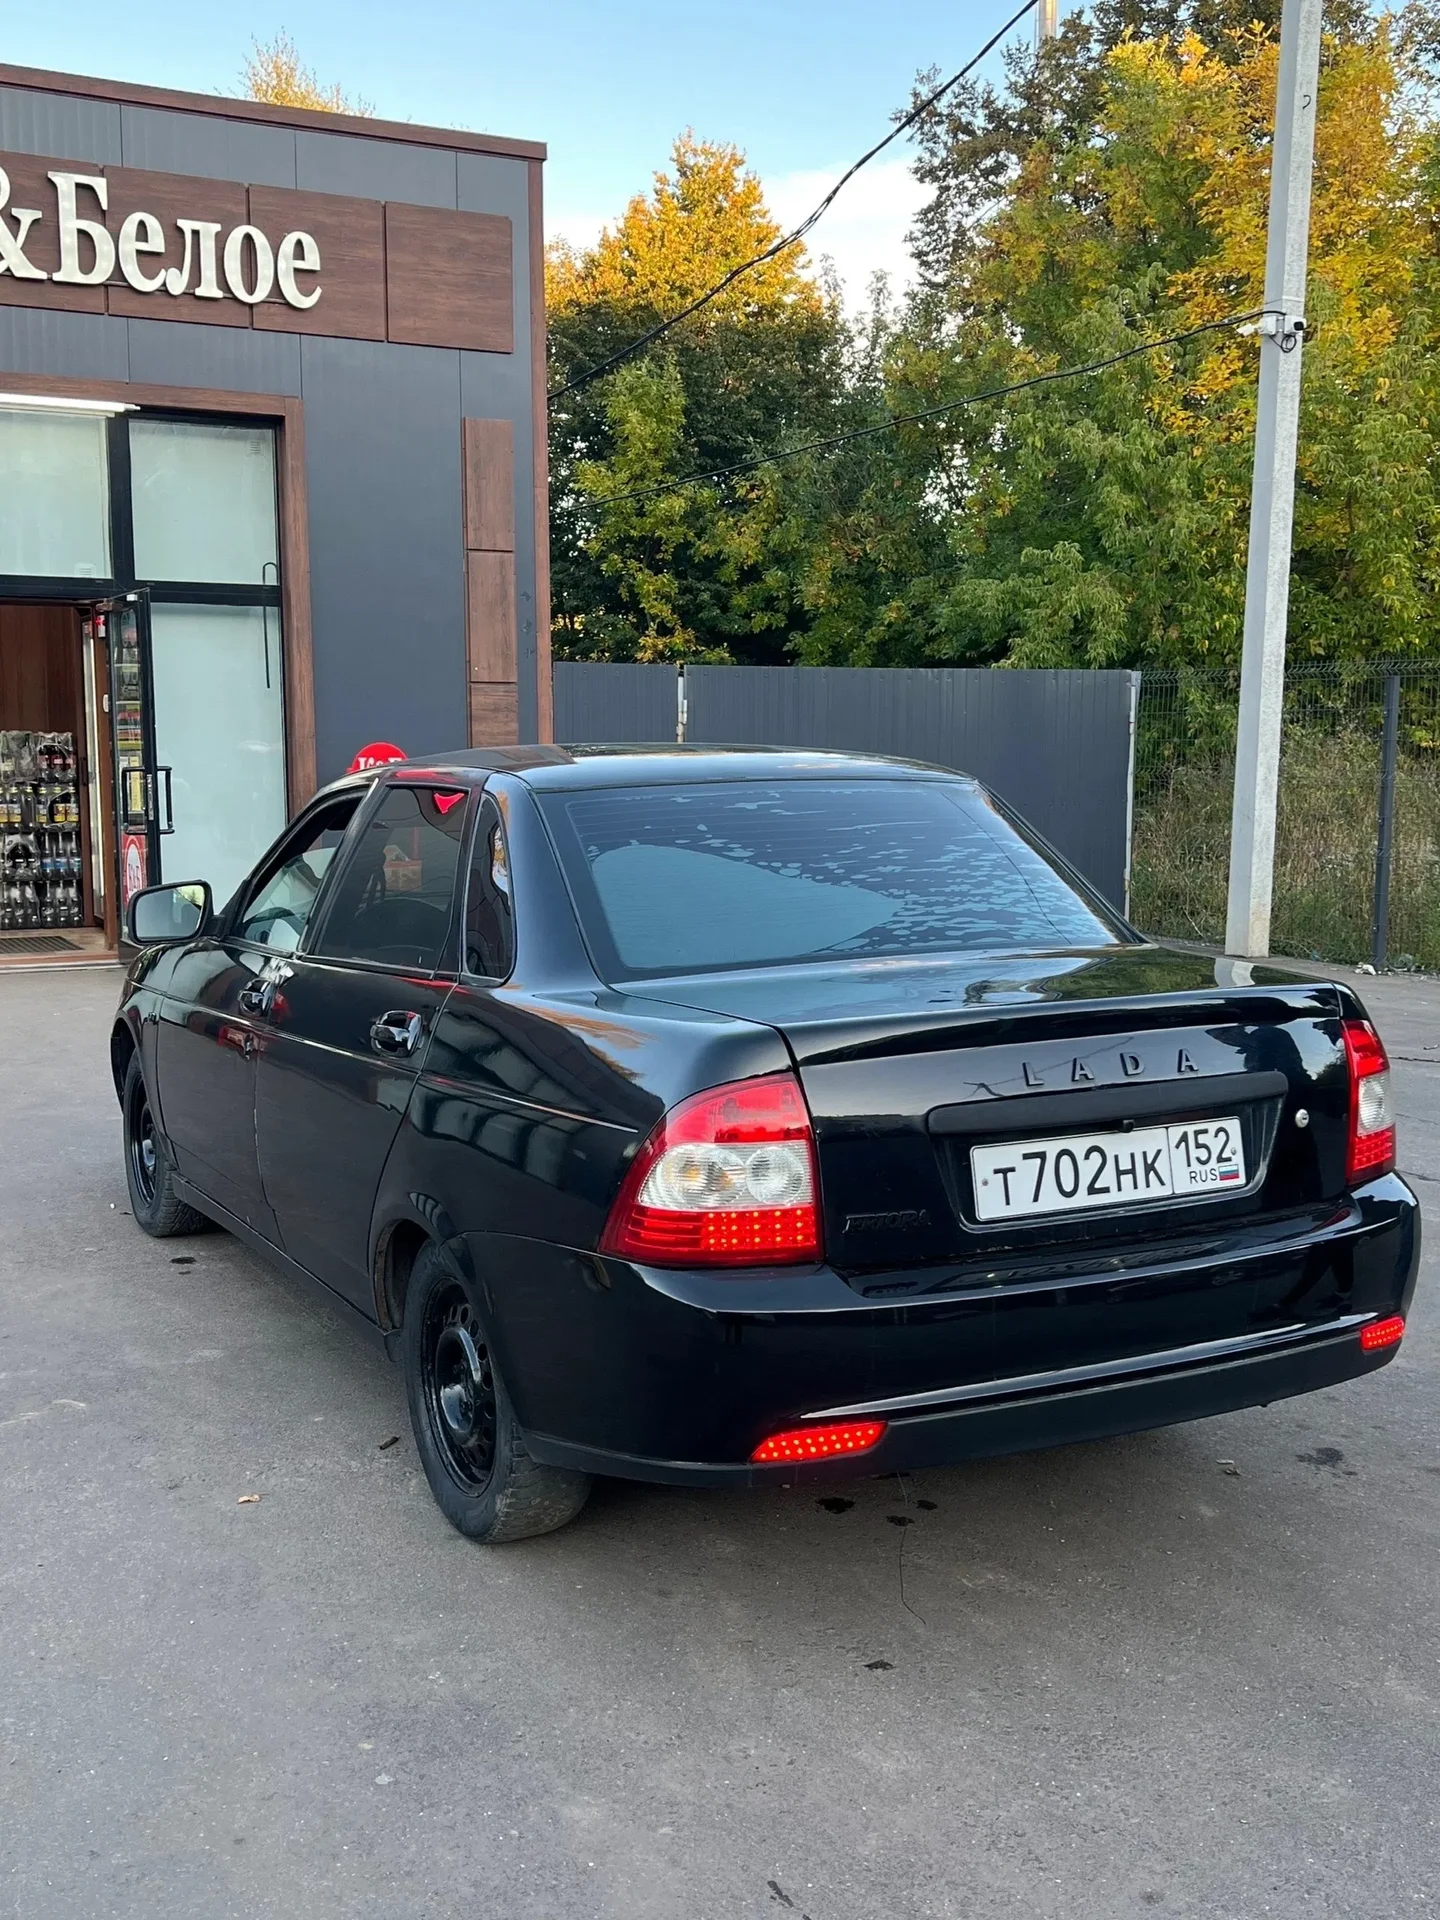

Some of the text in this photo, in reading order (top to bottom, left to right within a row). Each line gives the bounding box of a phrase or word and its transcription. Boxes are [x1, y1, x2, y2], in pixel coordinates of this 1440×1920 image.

[1022, 1049, 1199, 1087] LADA
[993, 1126, 1233, 1206] Т702НК 152
[1189, 1170, 1218, 1184] RUS
